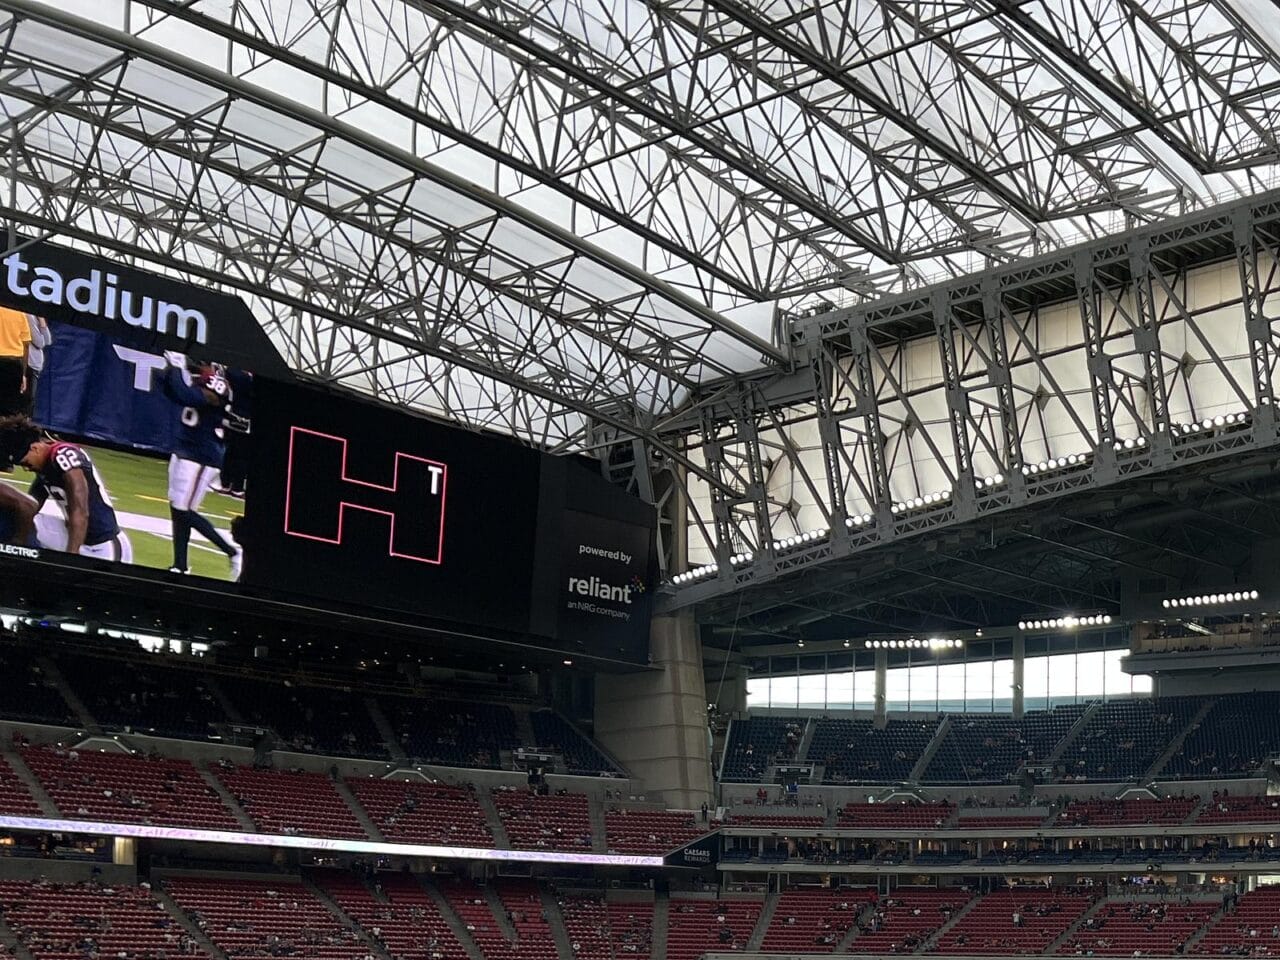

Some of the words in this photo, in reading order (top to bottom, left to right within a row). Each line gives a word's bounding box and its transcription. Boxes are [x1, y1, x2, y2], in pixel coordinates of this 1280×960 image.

[3, 252, 207, 344] tadium
[206, 375, 227, 395] 38
[56, 450, 81, 471] 82
[579, 545, 620, 561] powered
[620, 551, 632, 564] by
[568, 576, 632, 604] reliant
[577, 602, 596, 613] NRG
[596, 606, 631, 621] company
[684, 848, 710, 857] CAESARS
